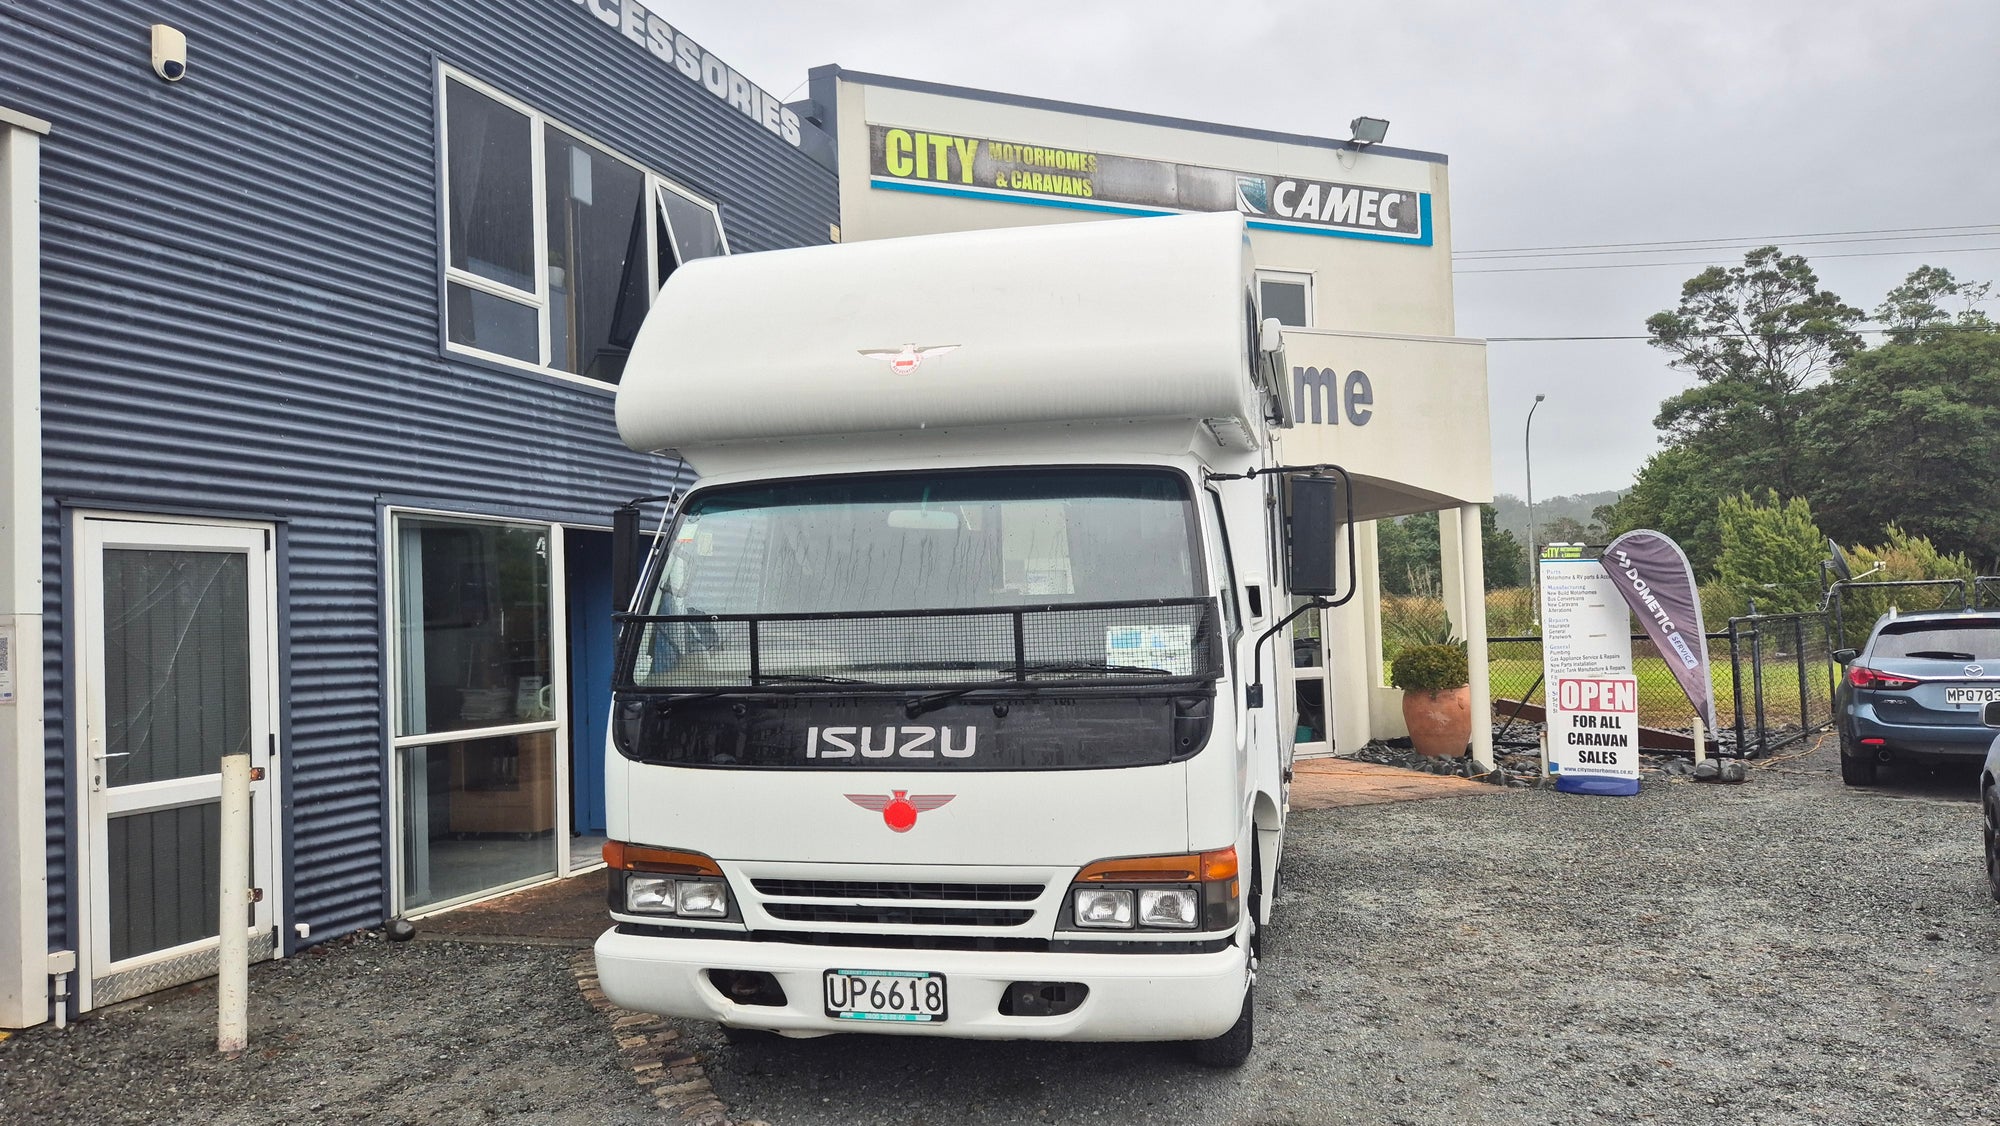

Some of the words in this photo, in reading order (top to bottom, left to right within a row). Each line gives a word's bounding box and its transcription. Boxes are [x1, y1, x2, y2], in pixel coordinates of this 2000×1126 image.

[571, 0, 801, 148] CESSORIES
[885, 129, 979, 184] CITY
[988, 142, 1098, 174] MOTORHOMES
[995, 171, 1008, 188] &
[1011, 171, 1093, 197] CARAVANS
[1273, 181, 1400, 228] CAMEC
[1625, 567, 1675, 634] DOMETIC
[1671, 636, 1695, 665] SERVICE
[1560, 680, 1634, 711] OPEN
[1573, 715, 1597, 728] FOR
[1600, 716, 1621, 729] ALL
[806, 726, 977, 758] ISUZU
[1567, 733, 1628, 747] CARAVAN
[1564, 766, 1634, 775] www.citymotorhomes.co.nz
[1578, 751, 1617, 764] SALES
[829, 978, 941, 1011] UP6618
